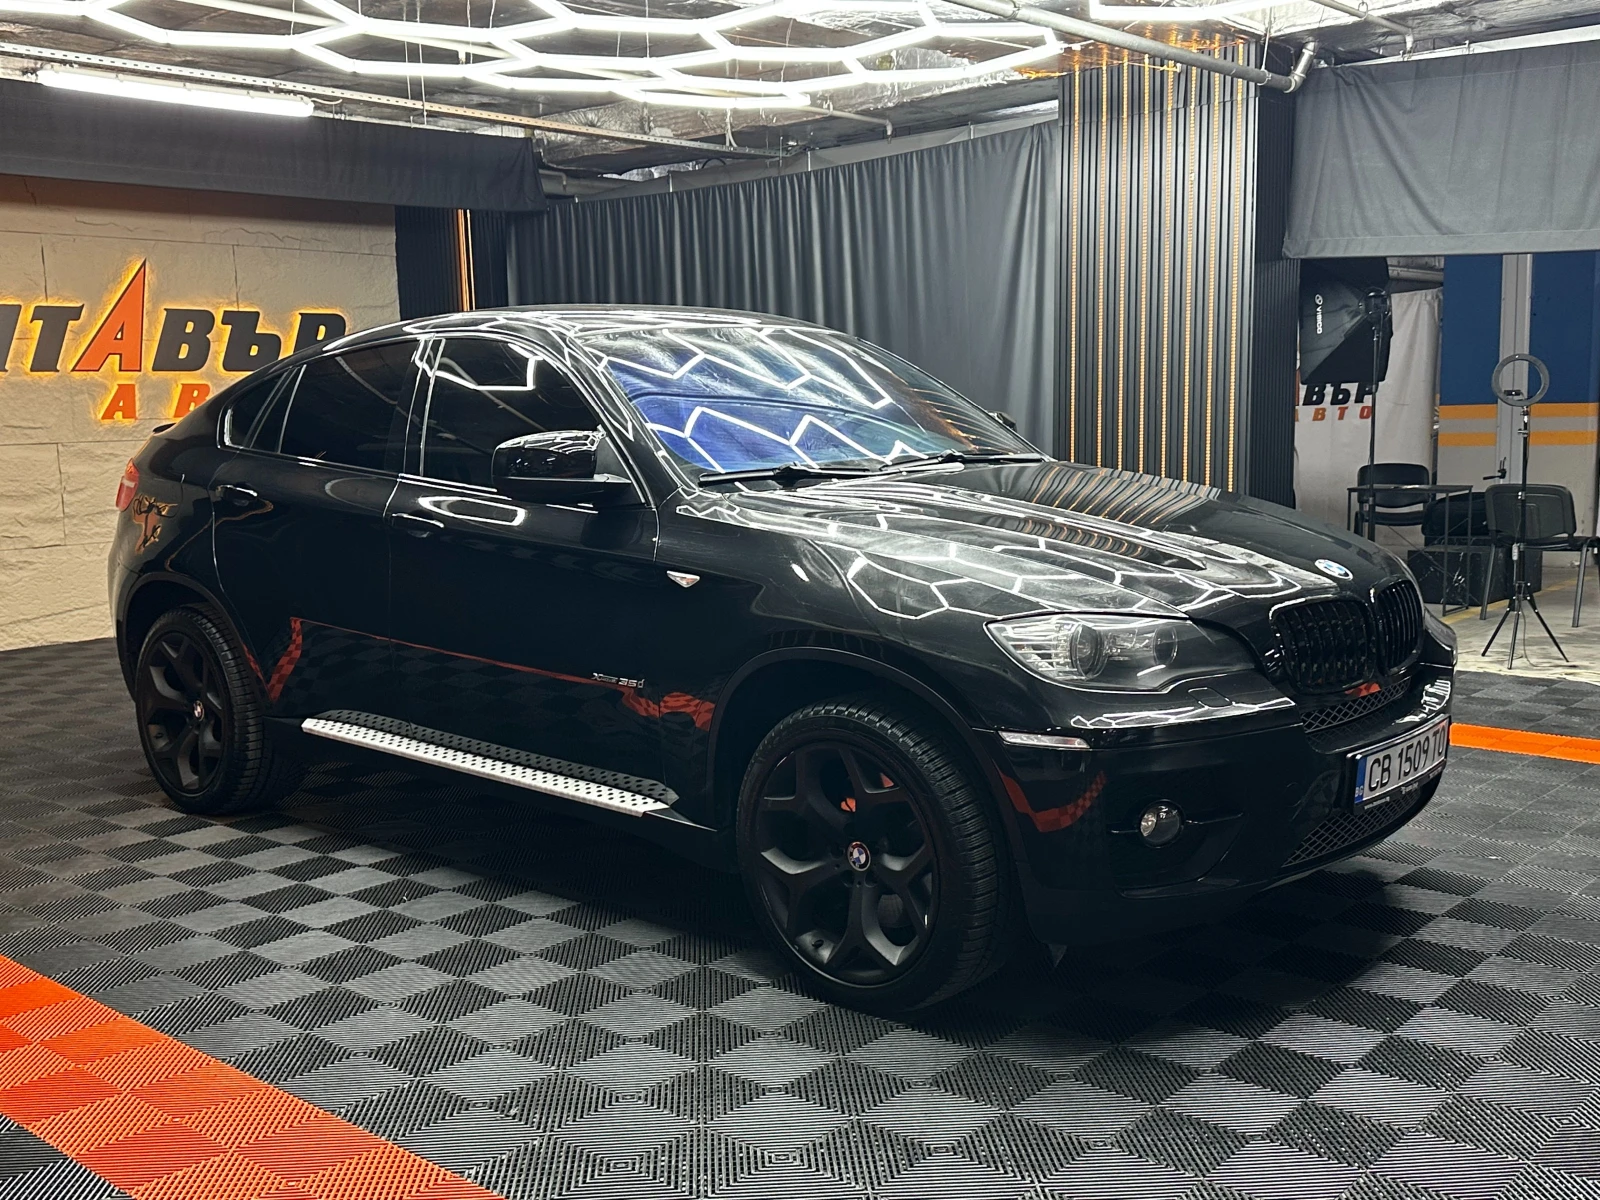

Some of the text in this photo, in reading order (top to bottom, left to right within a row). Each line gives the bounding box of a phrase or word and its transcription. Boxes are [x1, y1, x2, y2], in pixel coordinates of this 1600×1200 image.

[1368, 725, 1446, 792] CB 1509 TO
[1354, 785, 1364, 798] BG
